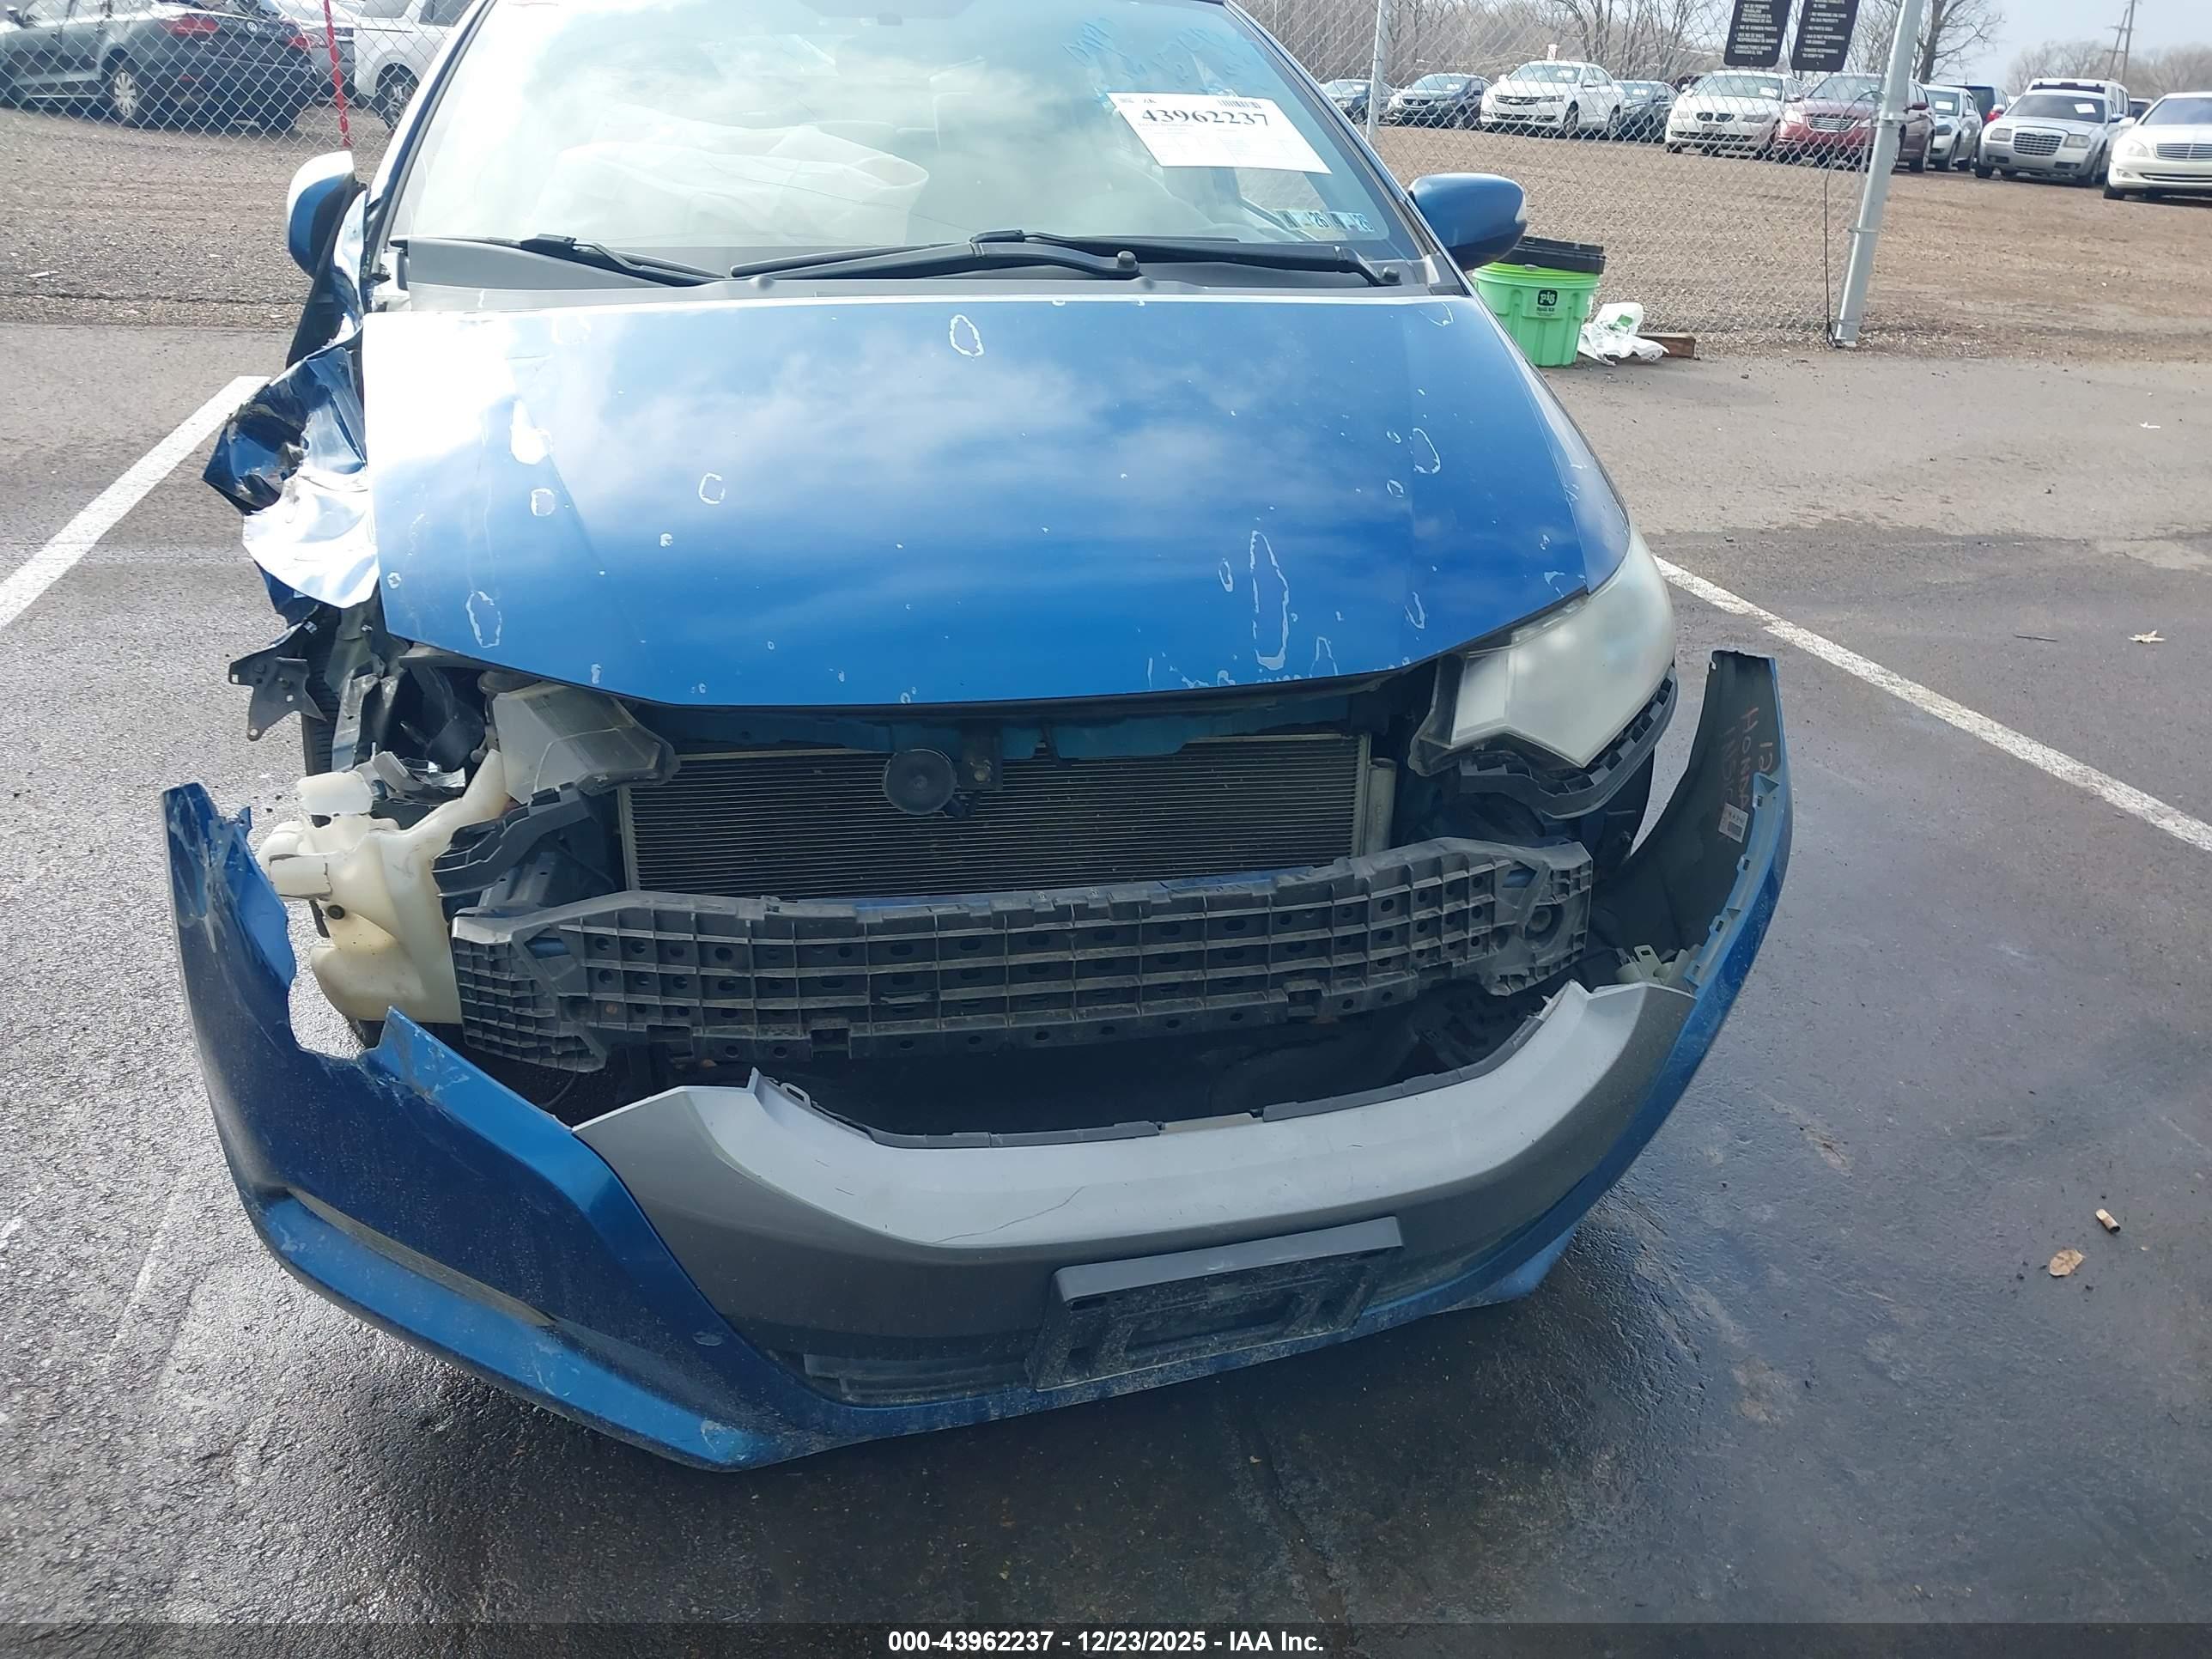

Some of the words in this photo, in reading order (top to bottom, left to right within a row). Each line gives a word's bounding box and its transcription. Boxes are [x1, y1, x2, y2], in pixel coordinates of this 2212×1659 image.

[1142, 109, 1268, 126] 43962237
[1540, 291, 1556, 304] pig
[1738, 707, 1759, 809] HONDA
